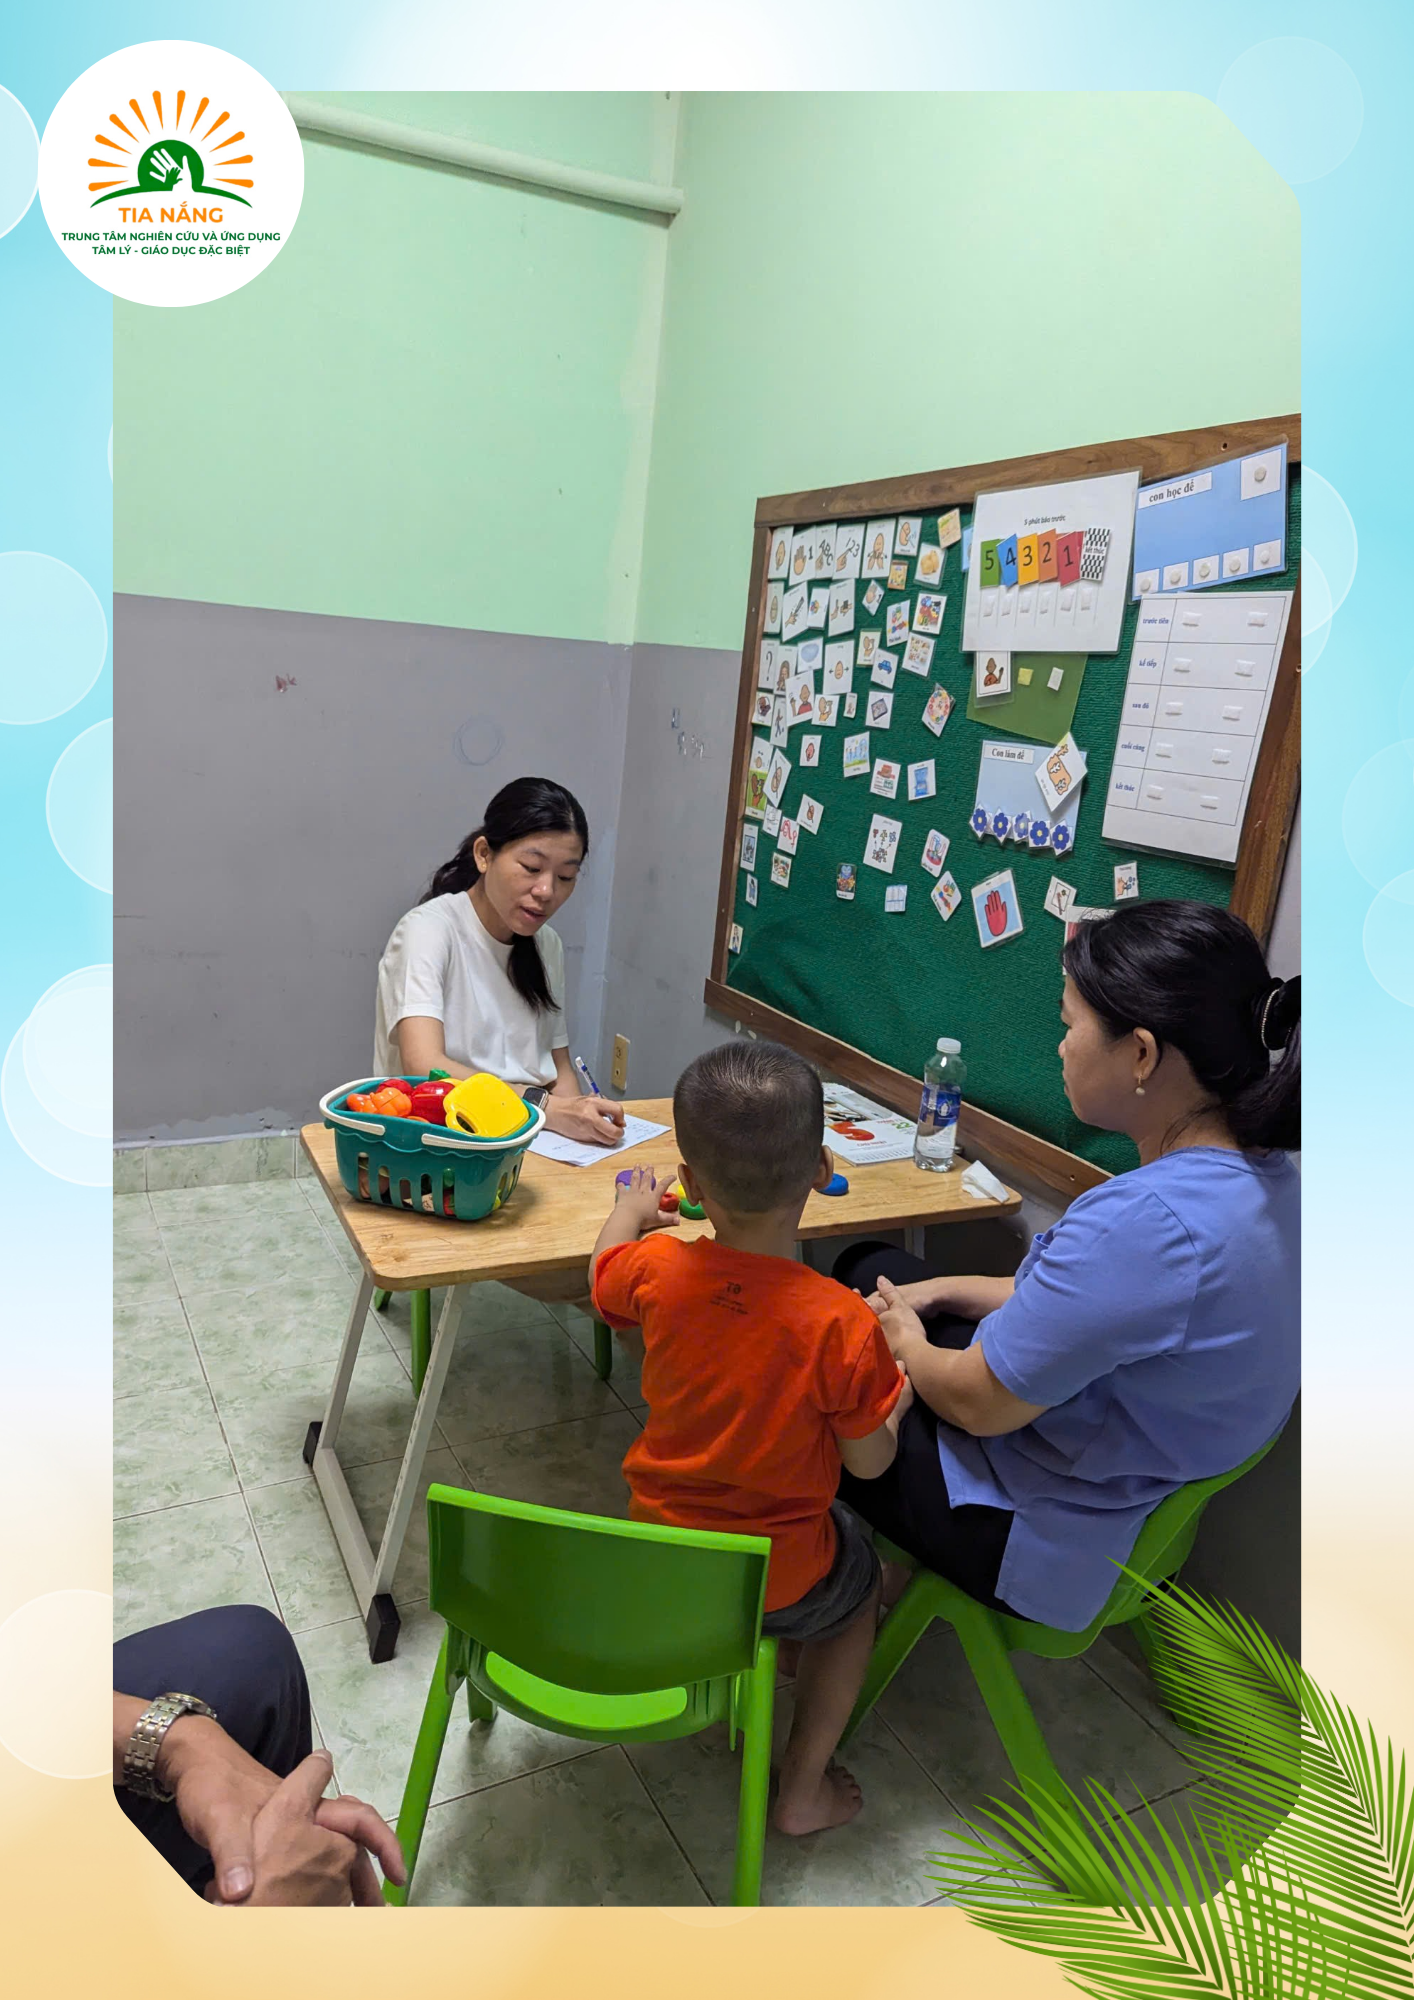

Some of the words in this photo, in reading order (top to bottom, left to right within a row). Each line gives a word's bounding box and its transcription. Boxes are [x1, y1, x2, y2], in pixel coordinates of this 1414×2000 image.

[1149, 492, 1164, 502] con
[1166, 486, 1182, 499] học
[984, 549, 994, 571] 5
[1005, 547, 1017, 566] 4
[1022, 545, 1033, 567] 3
[1042, 541, 1052, 564] 2
[1063, 545, 1074, 567] 1
[991, 747, 1004, 758] Con
